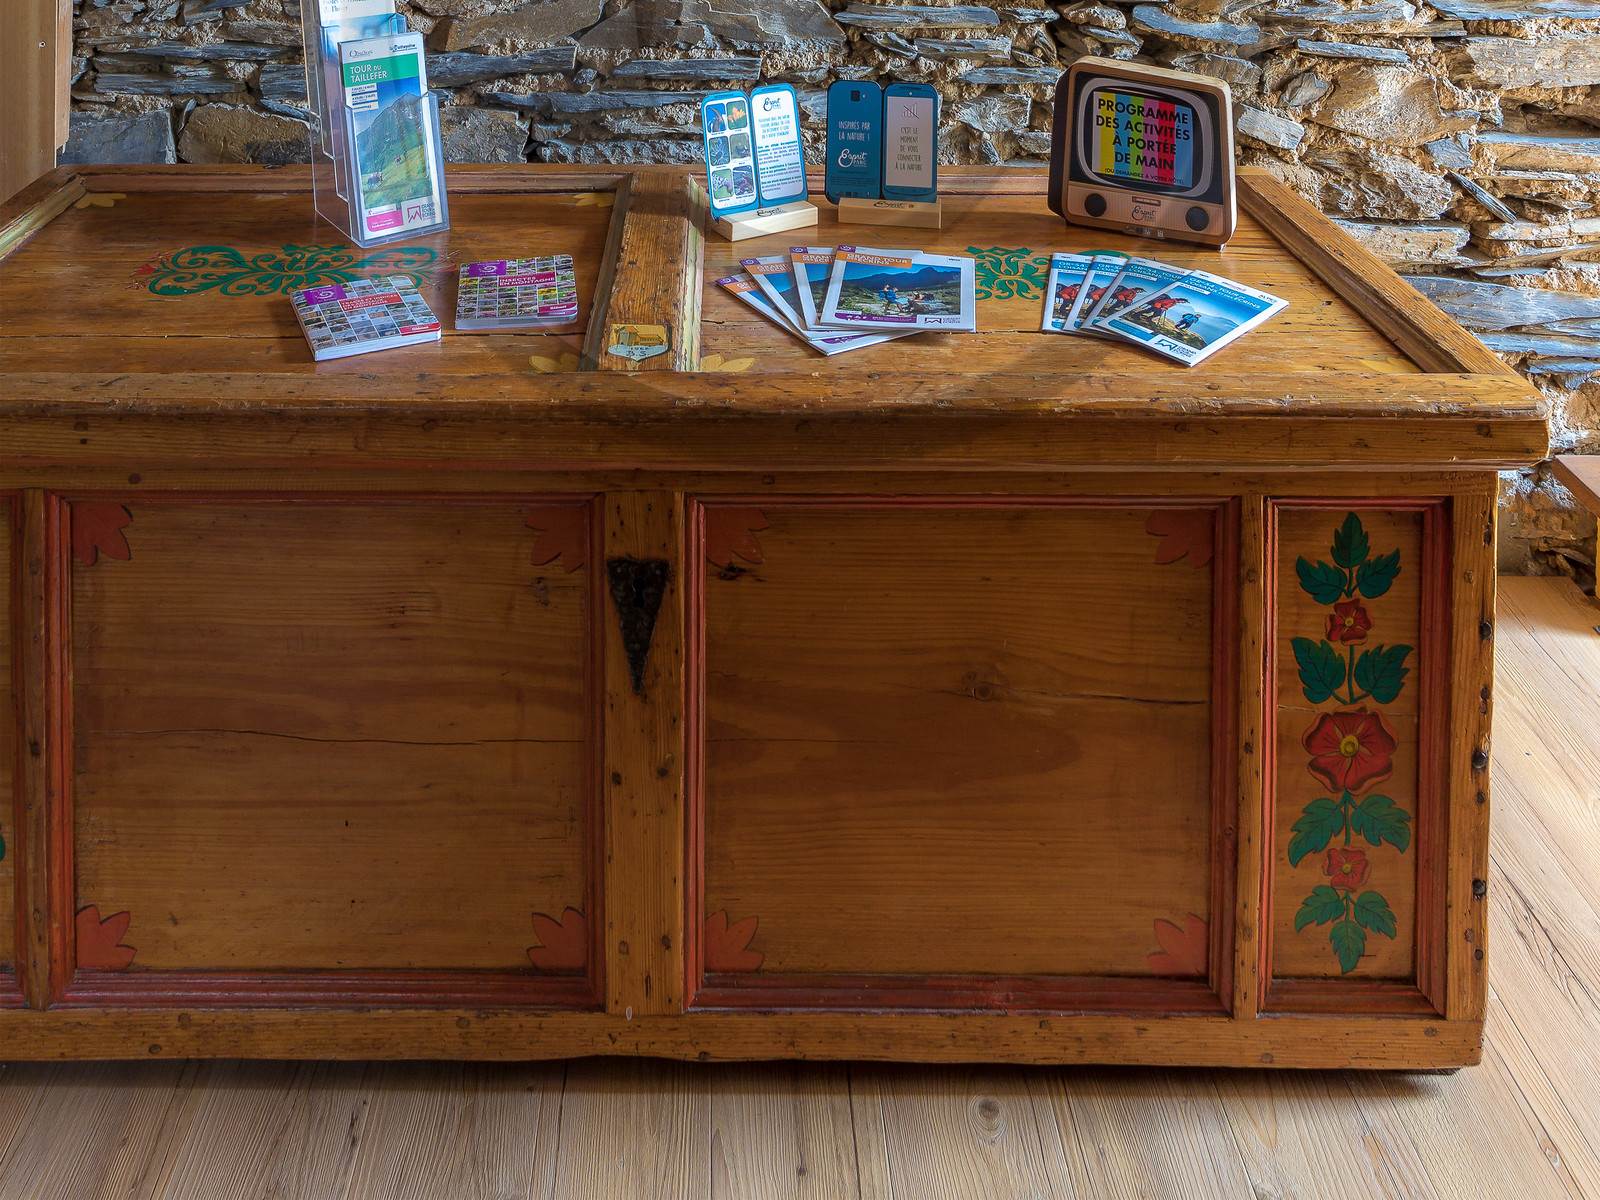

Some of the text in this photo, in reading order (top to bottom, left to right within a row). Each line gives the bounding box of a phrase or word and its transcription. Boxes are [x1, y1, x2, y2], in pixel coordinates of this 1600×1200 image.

[350, 64, 372, 75] TOUR
[350, 70, 388, 83] TAILLEFER
[1098, 98, 1189, 125] PROGRAMME
[838, 120, 870, 130] INSPIRÉS PAR
[1096, 115, 1191, 140] DES ACTIVITÉS
[838, 131, 845, 140] LA
[847, 132, 865, 141] NATURE
[1112, 131, 1176, 155] À PORTÉE
[838, 148, 868, 168] Esprit
[1115, 151, 1174, 170] DE MAIN
[1115, 169, 1143, 178] DEMANDEZ
[511, 277, 555, 285] MONTAGNE
